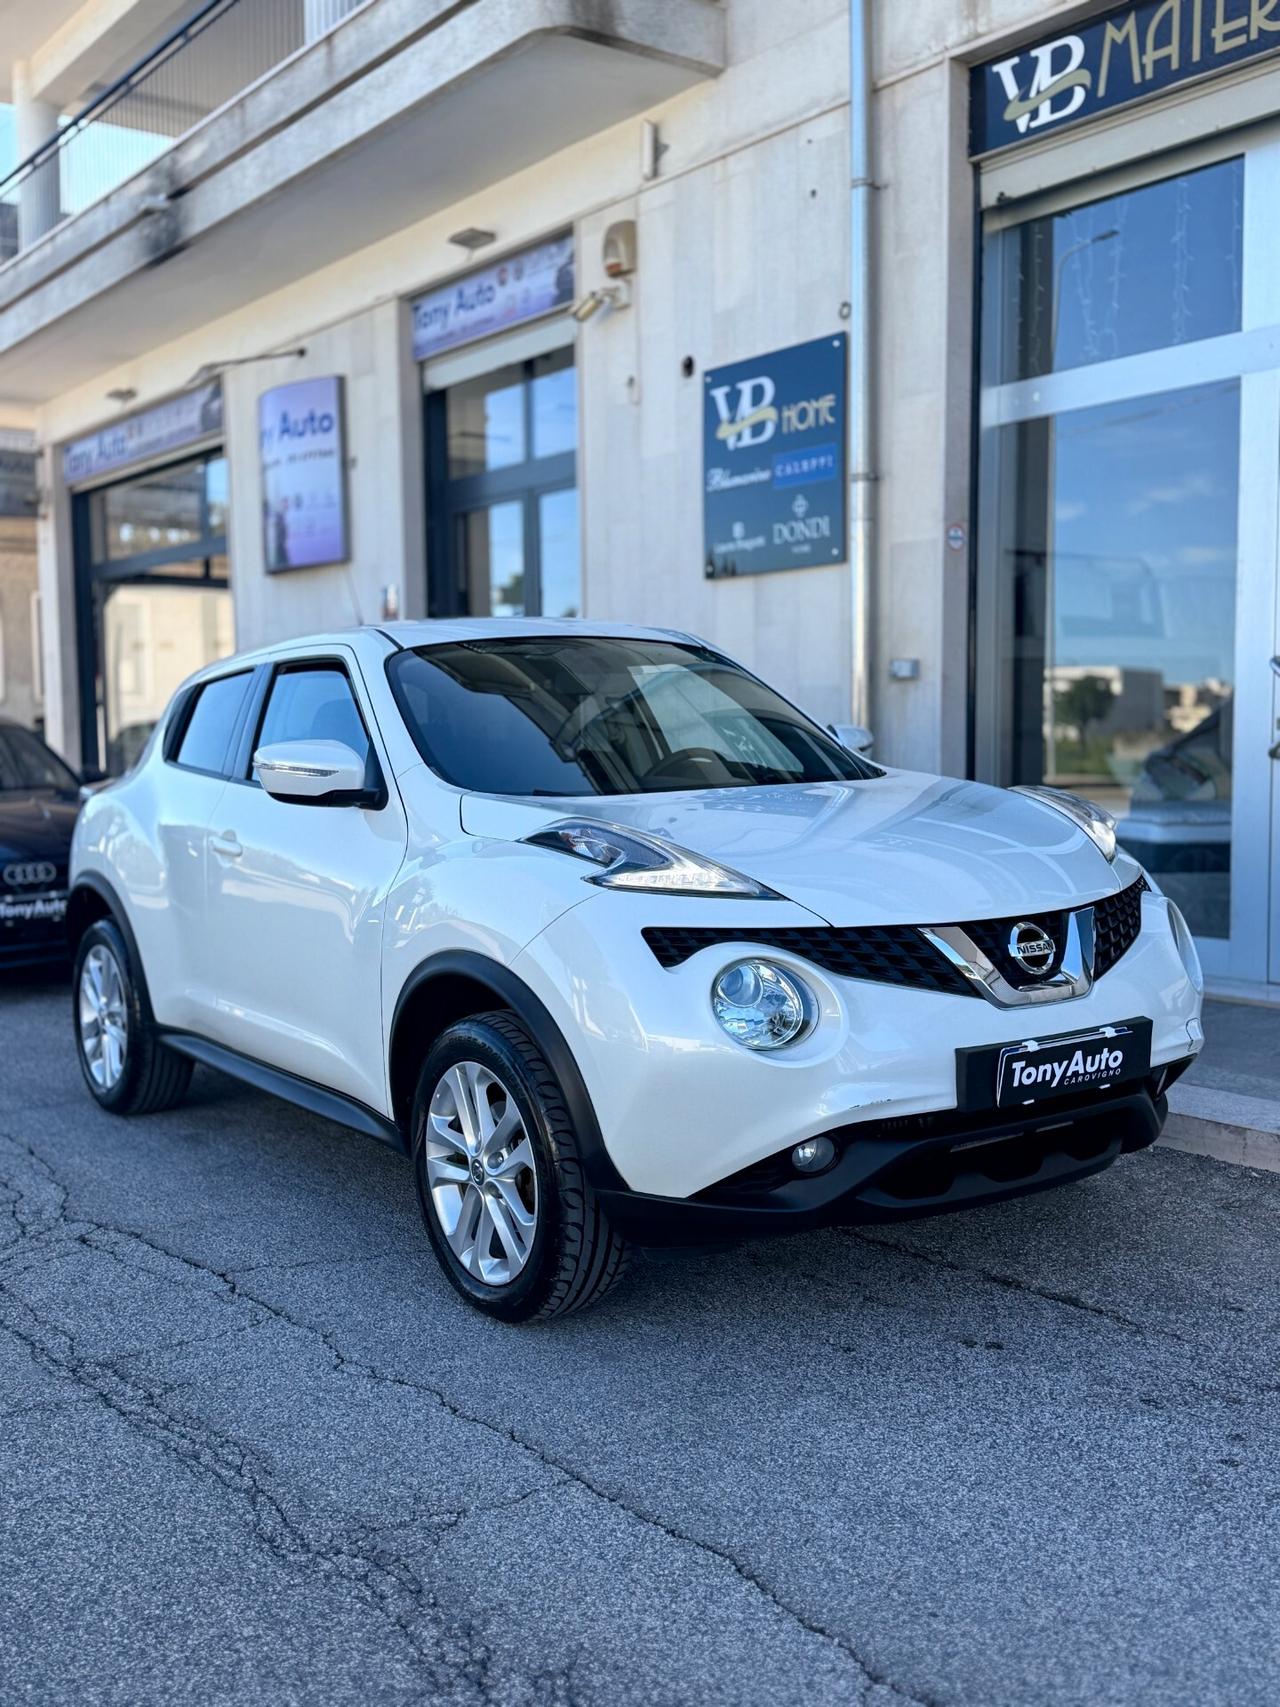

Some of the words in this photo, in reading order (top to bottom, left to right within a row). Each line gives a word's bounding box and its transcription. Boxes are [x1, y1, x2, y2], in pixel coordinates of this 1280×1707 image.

[455, 284, 495, 315] Auto
[278, 409, 334, 438] Auto
[1016, 939, 1054, 955] NISSAN
[1011, 1047, 1124, 1088] TonyAuto
[1063, 1068, 1122, 1086] CAROVIGNO
